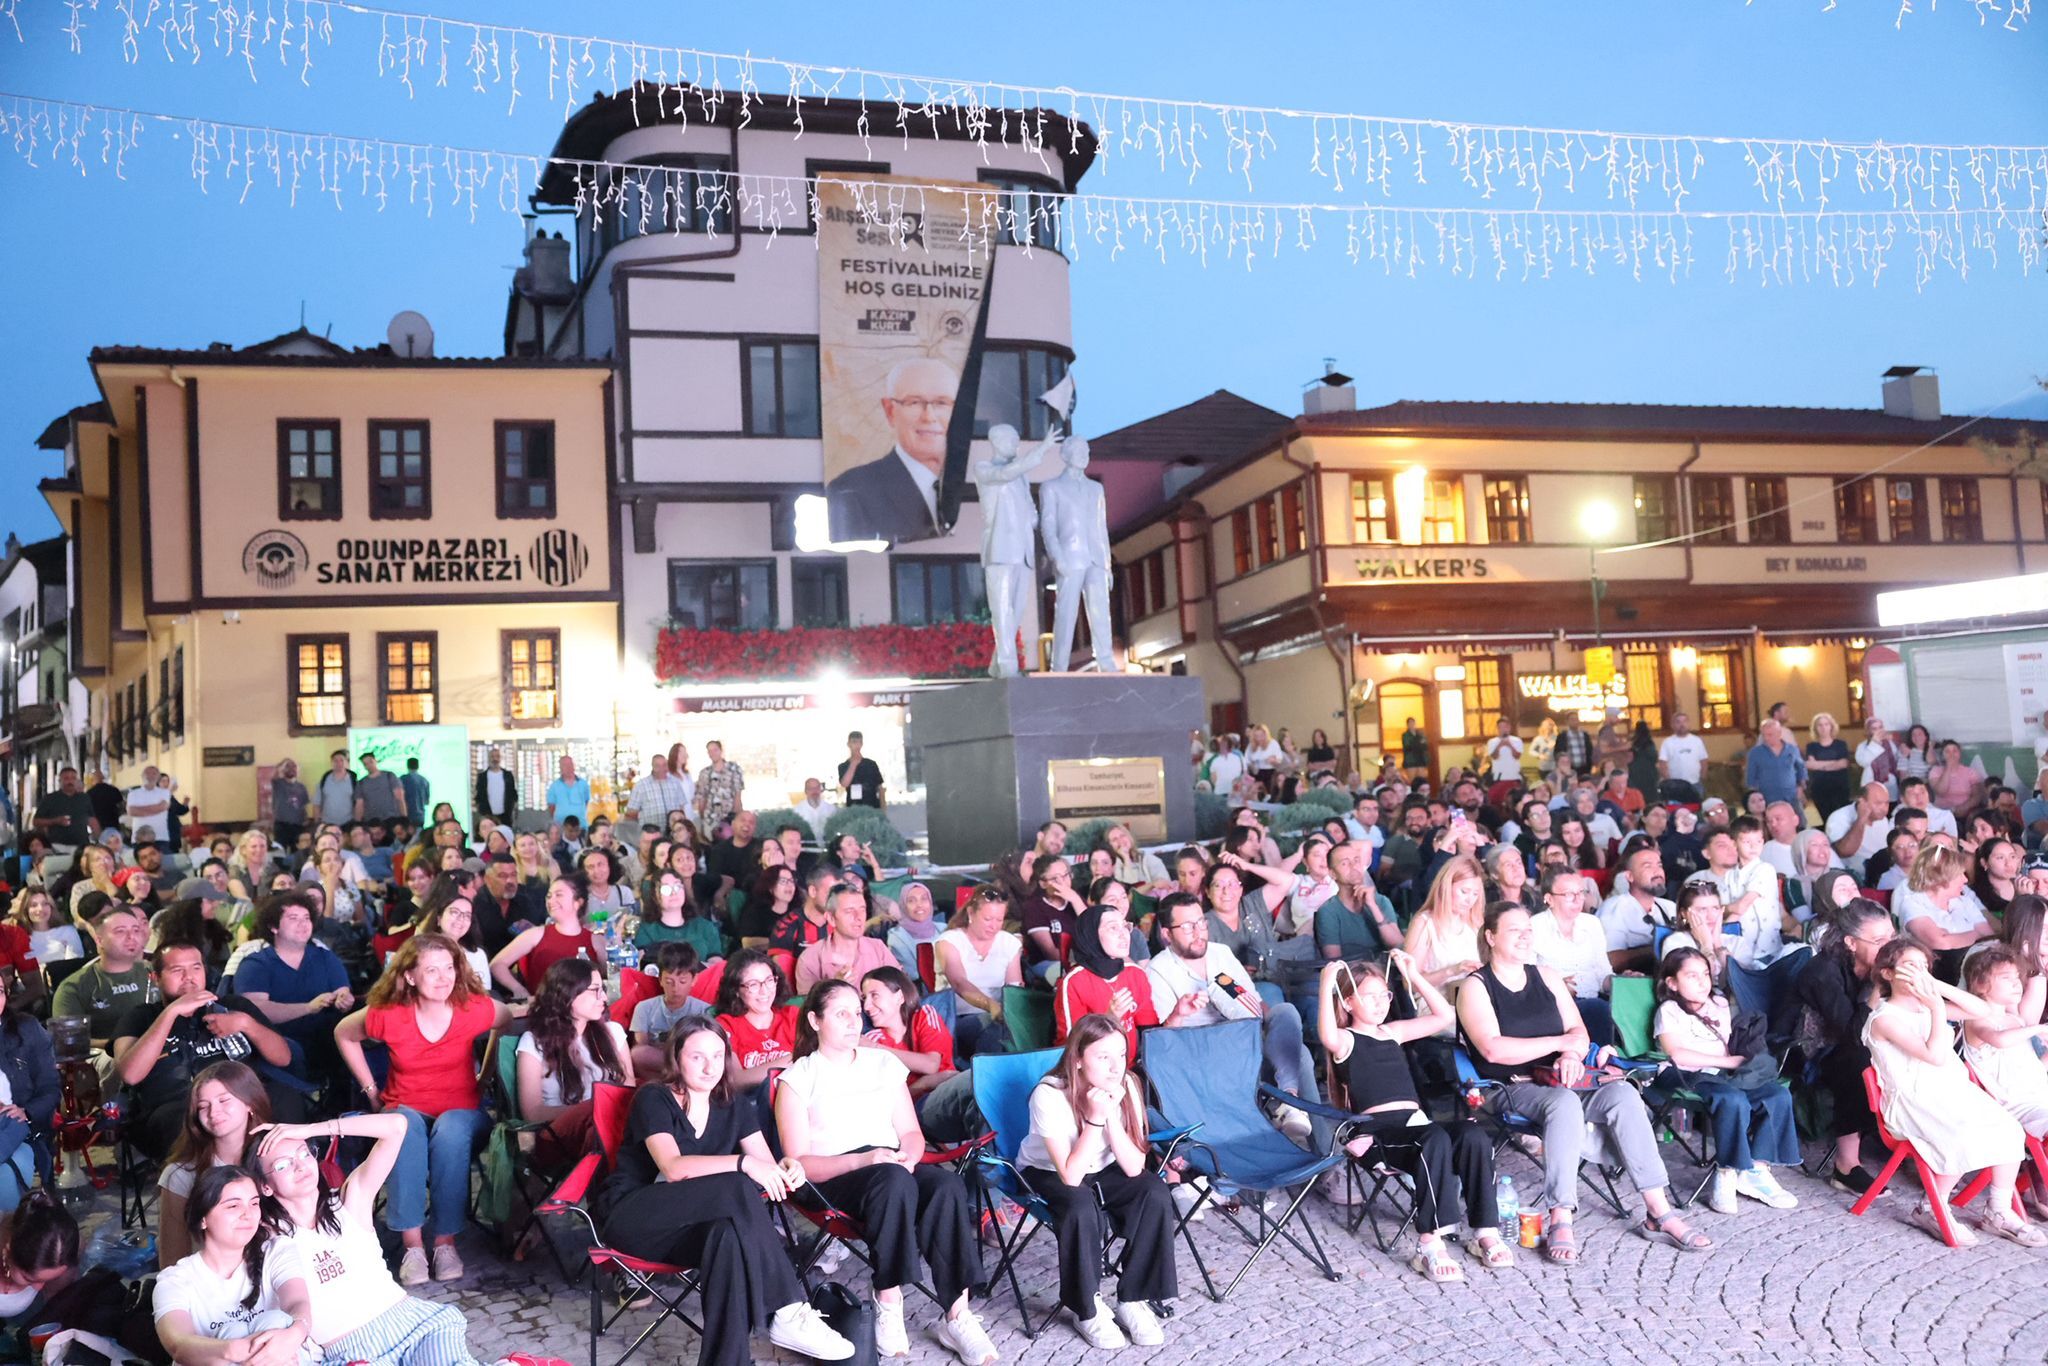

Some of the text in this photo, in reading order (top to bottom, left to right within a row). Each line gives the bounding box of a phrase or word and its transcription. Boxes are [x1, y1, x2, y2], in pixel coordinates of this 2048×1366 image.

[841, 258, 982, 280] FESTİVALİMİZE
[845, 281, 980, 301] HOŞ GELDİNİZ
[870, 310, 909, 321] KAZIM
[870, 320, 902, 331] KURT
[337, 538, 507, 560] ODUNPAZARI
[317, 554, 521, 583] SANAT MERKEZİ
[1355, 558, 1487, 578] WALKER'S
[702, 699, 740, 710] MASAL
[742, 697, 784, 709] HEDİYE
[873, 694, 901, 705] PARK
[317, 1260, 346, 1284] 1992
